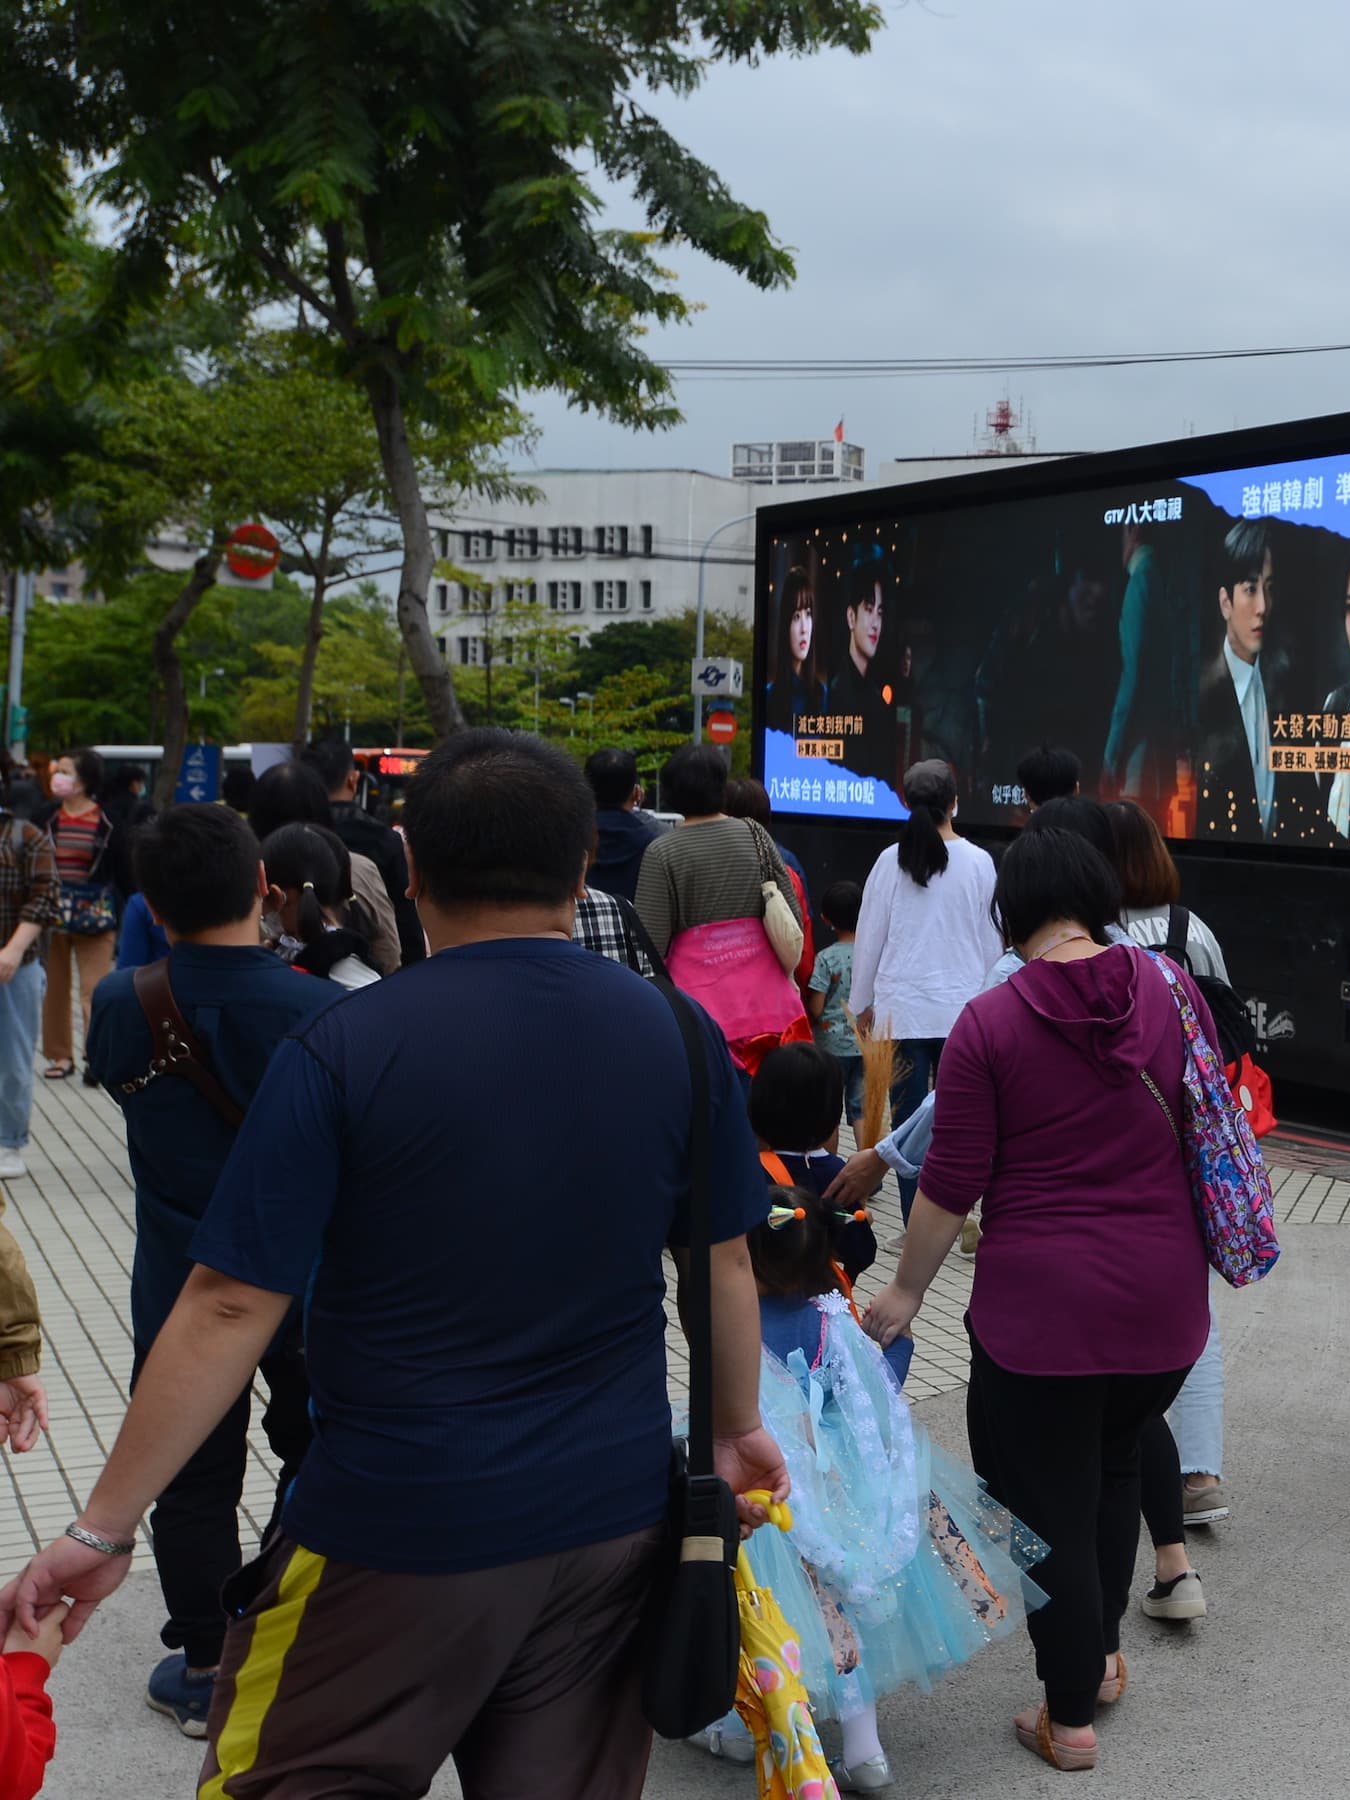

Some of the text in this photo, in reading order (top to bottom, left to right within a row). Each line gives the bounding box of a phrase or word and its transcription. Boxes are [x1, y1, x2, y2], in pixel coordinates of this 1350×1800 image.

[1124, 497, 1183, 524] 八大電視
[1242, 476, 1323, 517] 強檔韓劇
[769, 777, 875, 805] 八大綜合台 晚間10點
